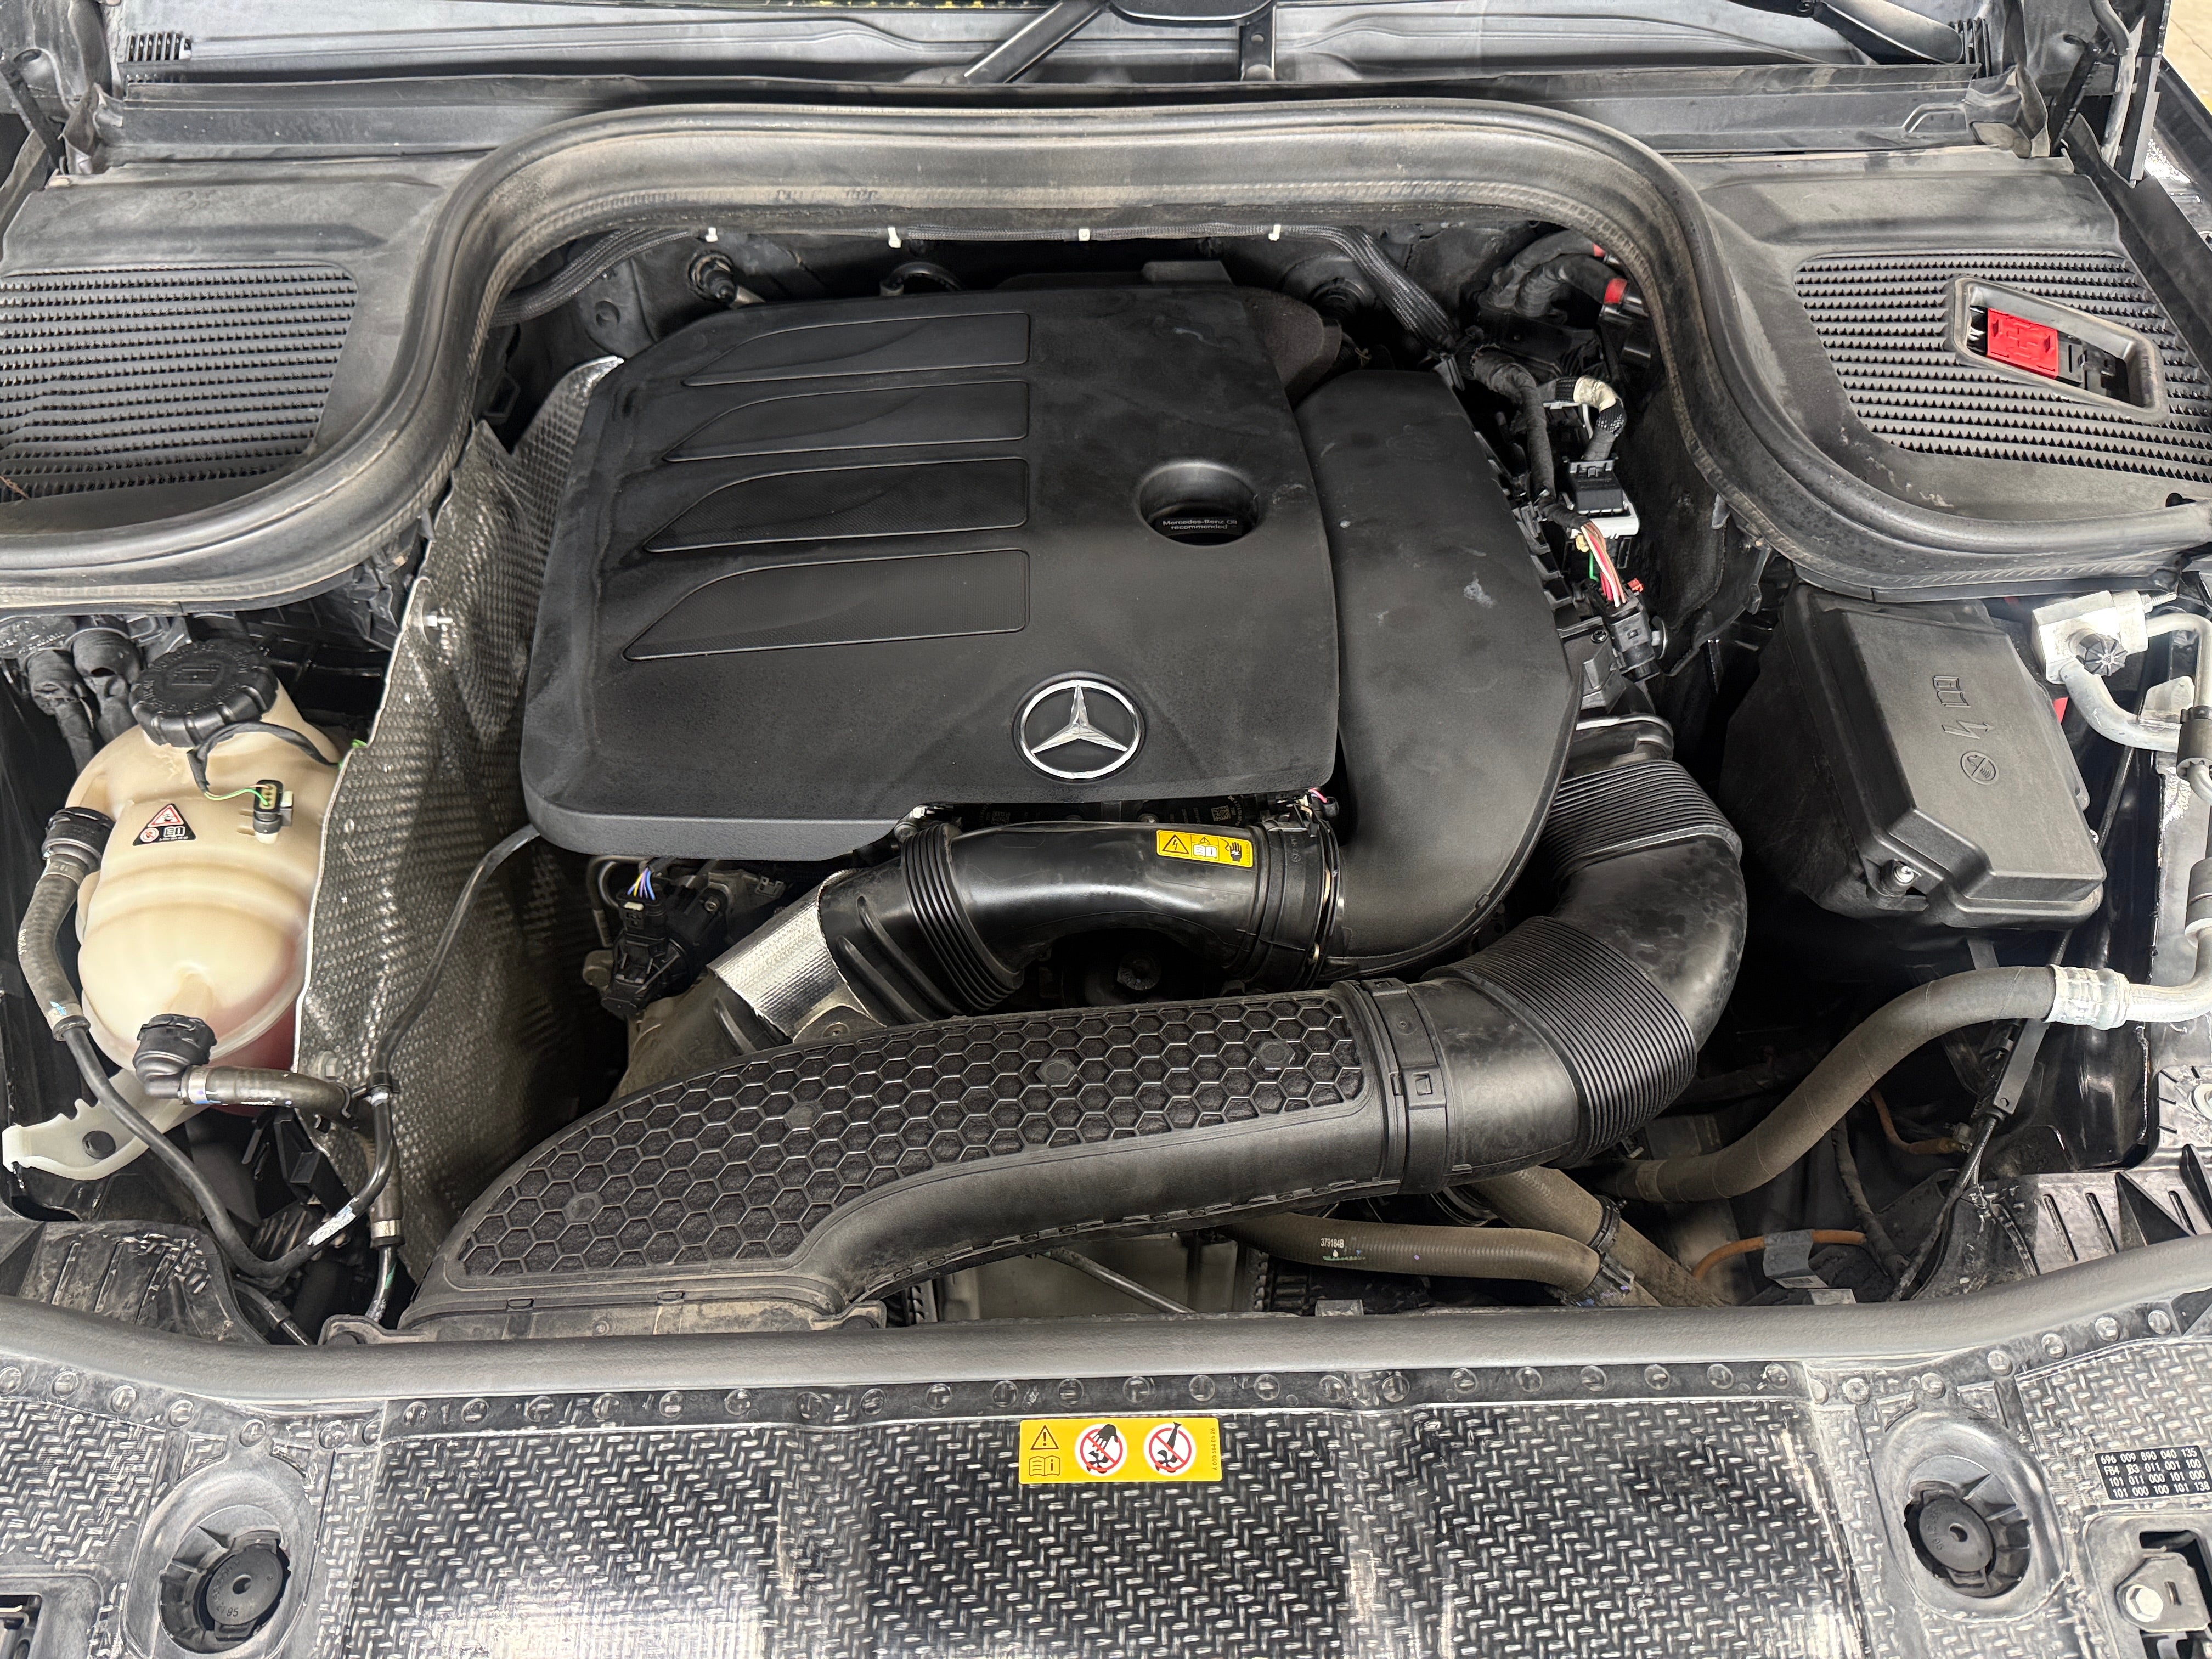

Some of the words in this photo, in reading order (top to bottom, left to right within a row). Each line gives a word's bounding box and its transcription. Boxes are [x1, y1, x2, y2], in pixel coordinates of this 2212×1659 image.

[2101, 1455, 2117, 1465] 696
[2120, 1453, 2136, 1463] 009
[2141, 1451, 2157, 1461] 890
[2160, 1449, 2177, 1459] 040
[2181, 1448, 2197, 1458] 135
[2104, 1466, 2120, 1476] FB4
[2144, 1462, 2160, 1472] 011
[2165, 1461, 2181, 1471] 001
[2186, 1459, 2202, 1469] 100
[2109, 1477, 2125, 1487] 101
[2128, 1475, 2145, 1486] 011
[2148, 1474, 2165, 1483] 000
[2170, 1472, 2185, 1482] 101
[2189, 1470, 2206, 1480] 000
[2113, 1488, 2129, 1498] 101
[2132, 1487, 2149, 1497] 000
[2153, 1485, 2170, 1494] 100
[2174, 1483, 2189, 1493] 101
[2194, 1482, 2210, 1491] 138
